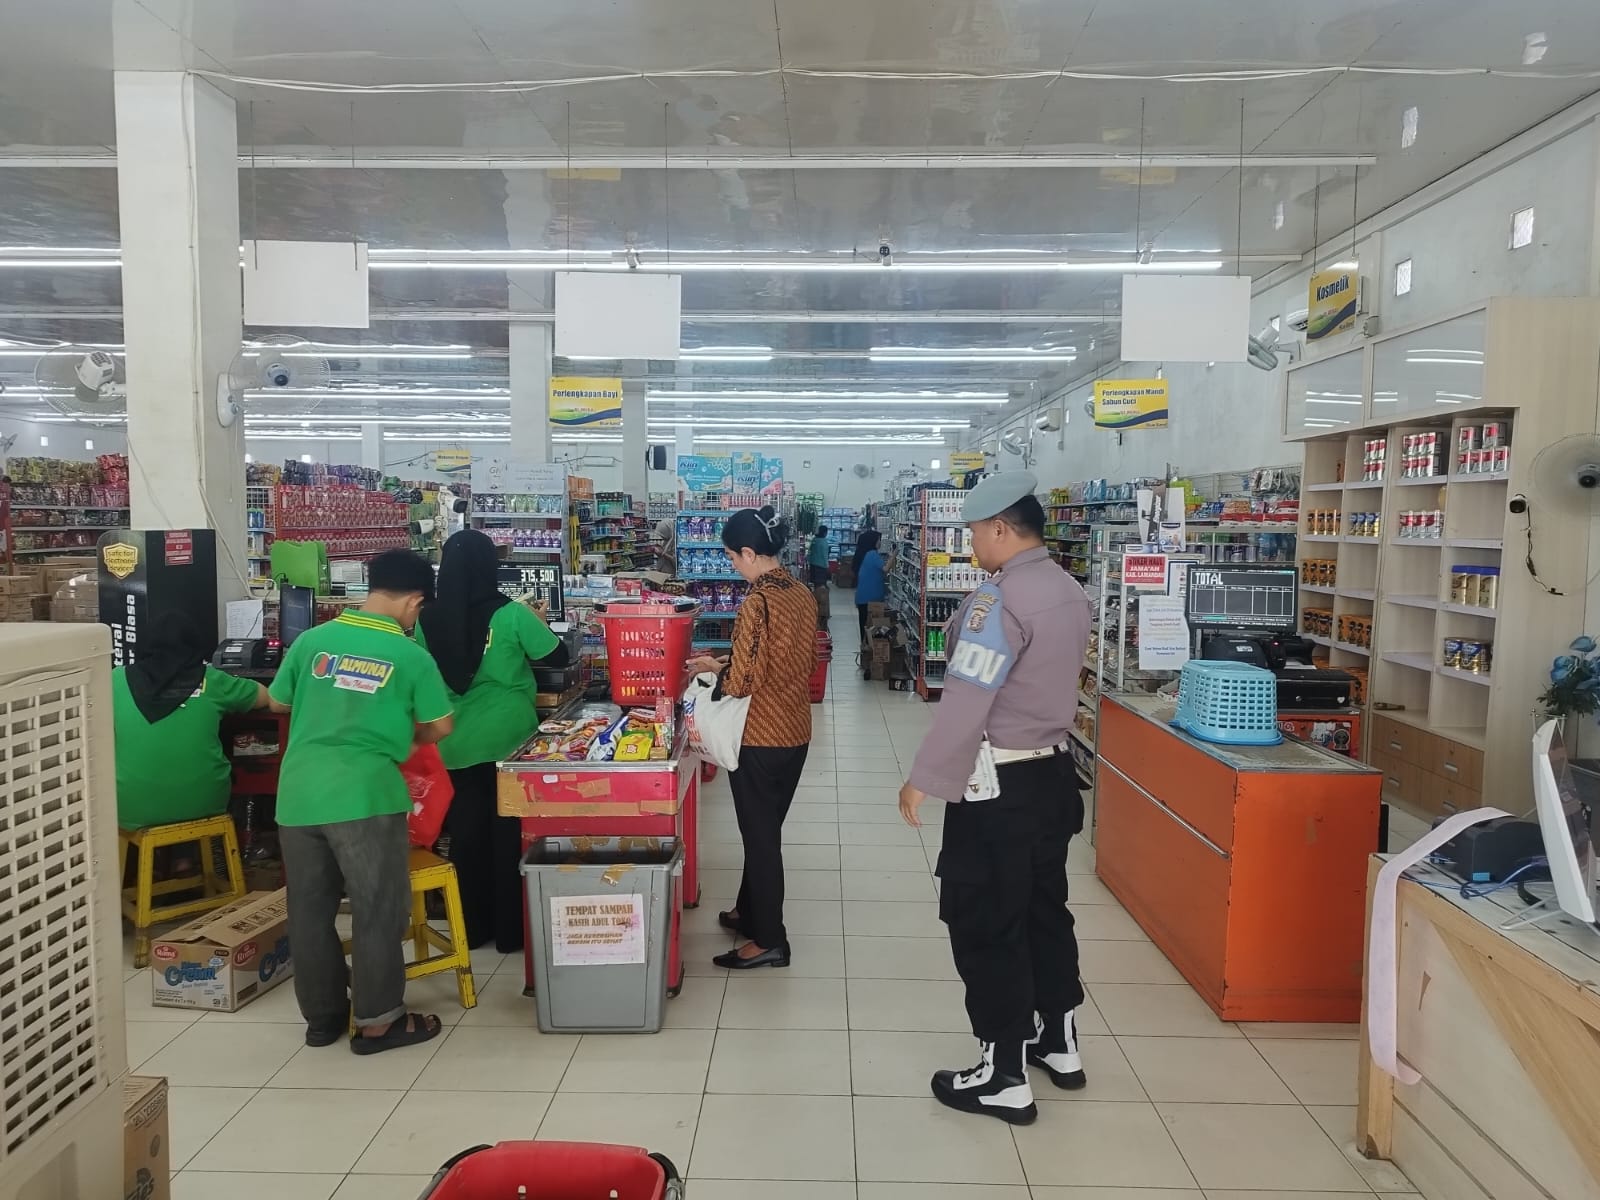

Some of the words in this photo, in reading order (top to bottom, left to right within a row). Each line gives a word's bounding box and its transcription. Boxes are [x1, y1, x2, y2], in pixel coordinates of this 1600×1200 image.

[1316, 275, 1349, 302] Kosmetik
[552, 390, 602, 399] Perlengkapan
[602, 391, 618, 399] Bayi
[1102, 389, 1145, 397] Perlengkapan
[1195, 572, 1224, 585] TOTAL
[125, 594, 137, 643] Biasa
[339, 657, 388, 678] ALMUNA
[565, 905, 598, 916] TEMPAT
[599, 904, 633, 914] SAMPAH
